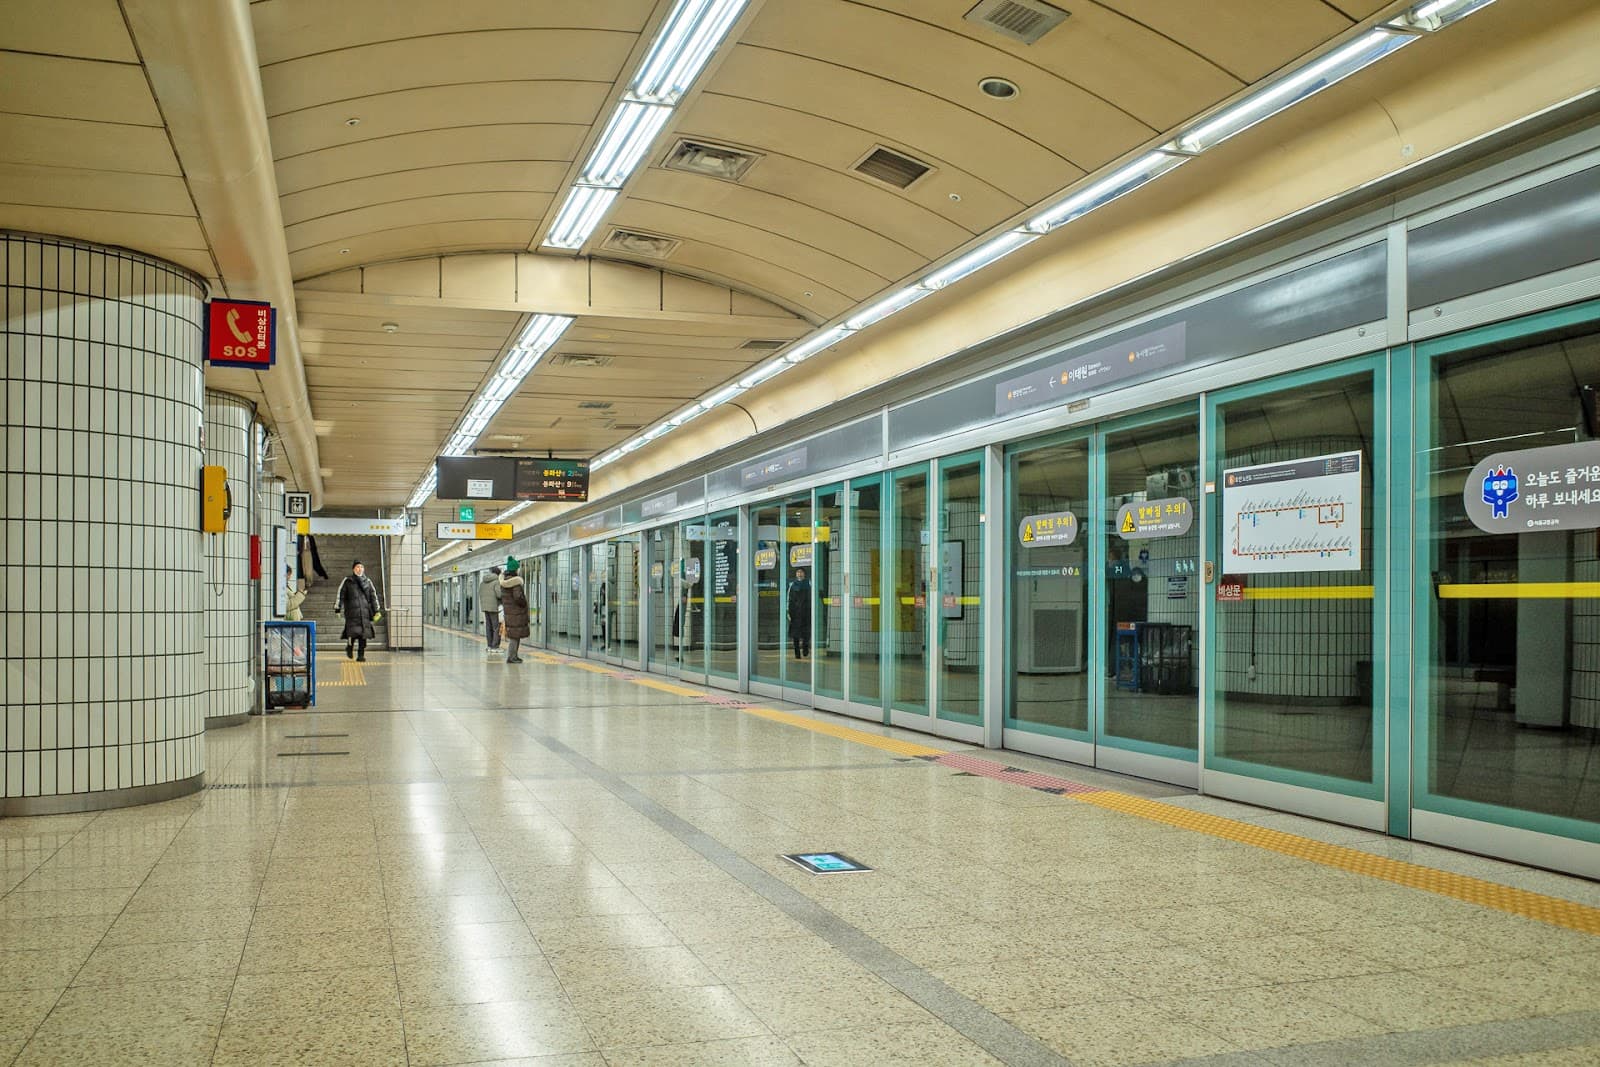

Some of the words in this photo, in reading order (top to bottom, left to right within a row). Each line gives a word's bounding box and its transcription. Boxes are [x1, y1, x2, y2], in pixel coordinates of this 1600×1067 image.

[257, 309, 267, 350] 비상인터폰
[223, 345, 257, 358] SOS
[1069, 364, 1088, 382] 이태원
[1525, 470, 1562, 487] 오늘도
[1564, 465, 1600, 485] 즐거운
[1525, 492, 1550, 509] 하루
[1552, 487, 1600, 506] 보내세요
[1138, 504, 1161, 519] 발빠짐
[1165, 501, 1187, 516] 주의!
[1217, 584, 1241, 597] 비상문
